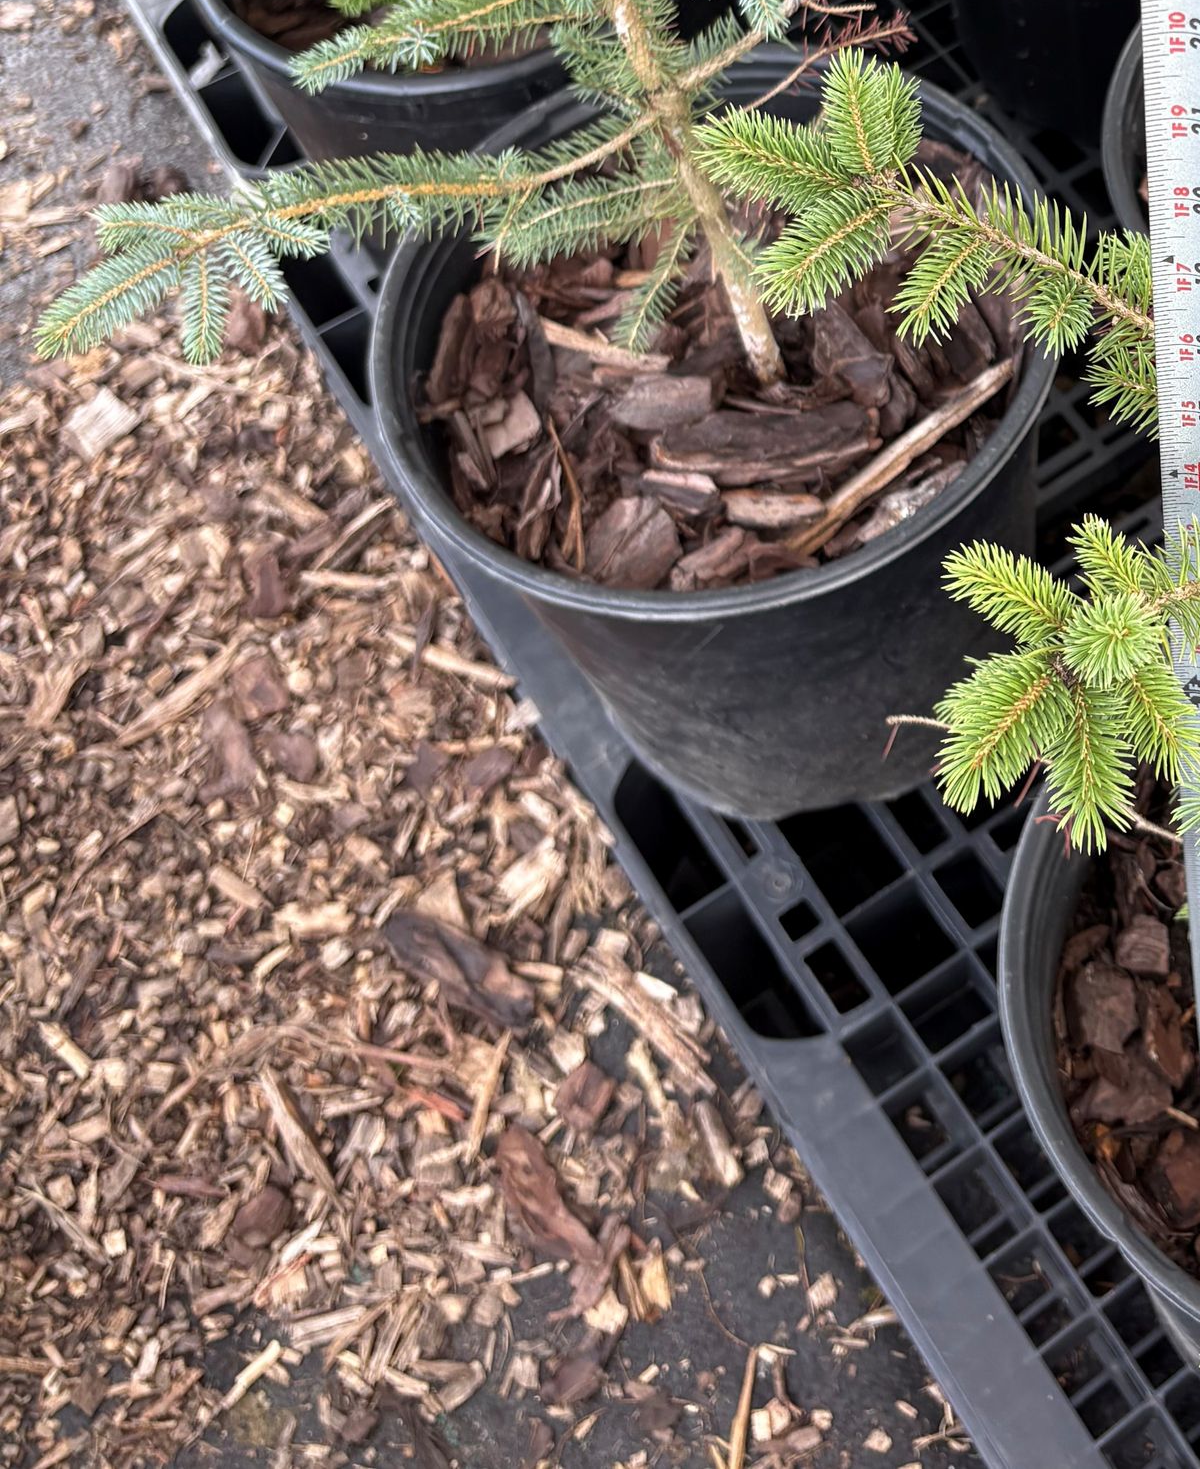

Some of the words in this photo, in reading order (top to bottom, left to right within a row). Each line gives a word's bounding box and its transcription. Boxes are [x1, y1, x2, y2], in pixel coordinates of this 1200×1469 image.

[1168, 11, 1185, 30] 10
[1169, 37, 1186, 54] 1F
[1171, 105, 1187, 117] 9
[1172, 123, 1187, 138] 1F
[1173, 186, 1189, 197] 8
[1174, 203, 1189, 218] 1F
[1176, 262, 1191, 272] 7
[1176, 278, 1191, 292] 1F
[1178, 334, 1194, 344] 6
[1179, 348, 1194, 362] 1F
[1181, 401, 1196, 409] 5
[1182, 415, 1196, 428] 1F
